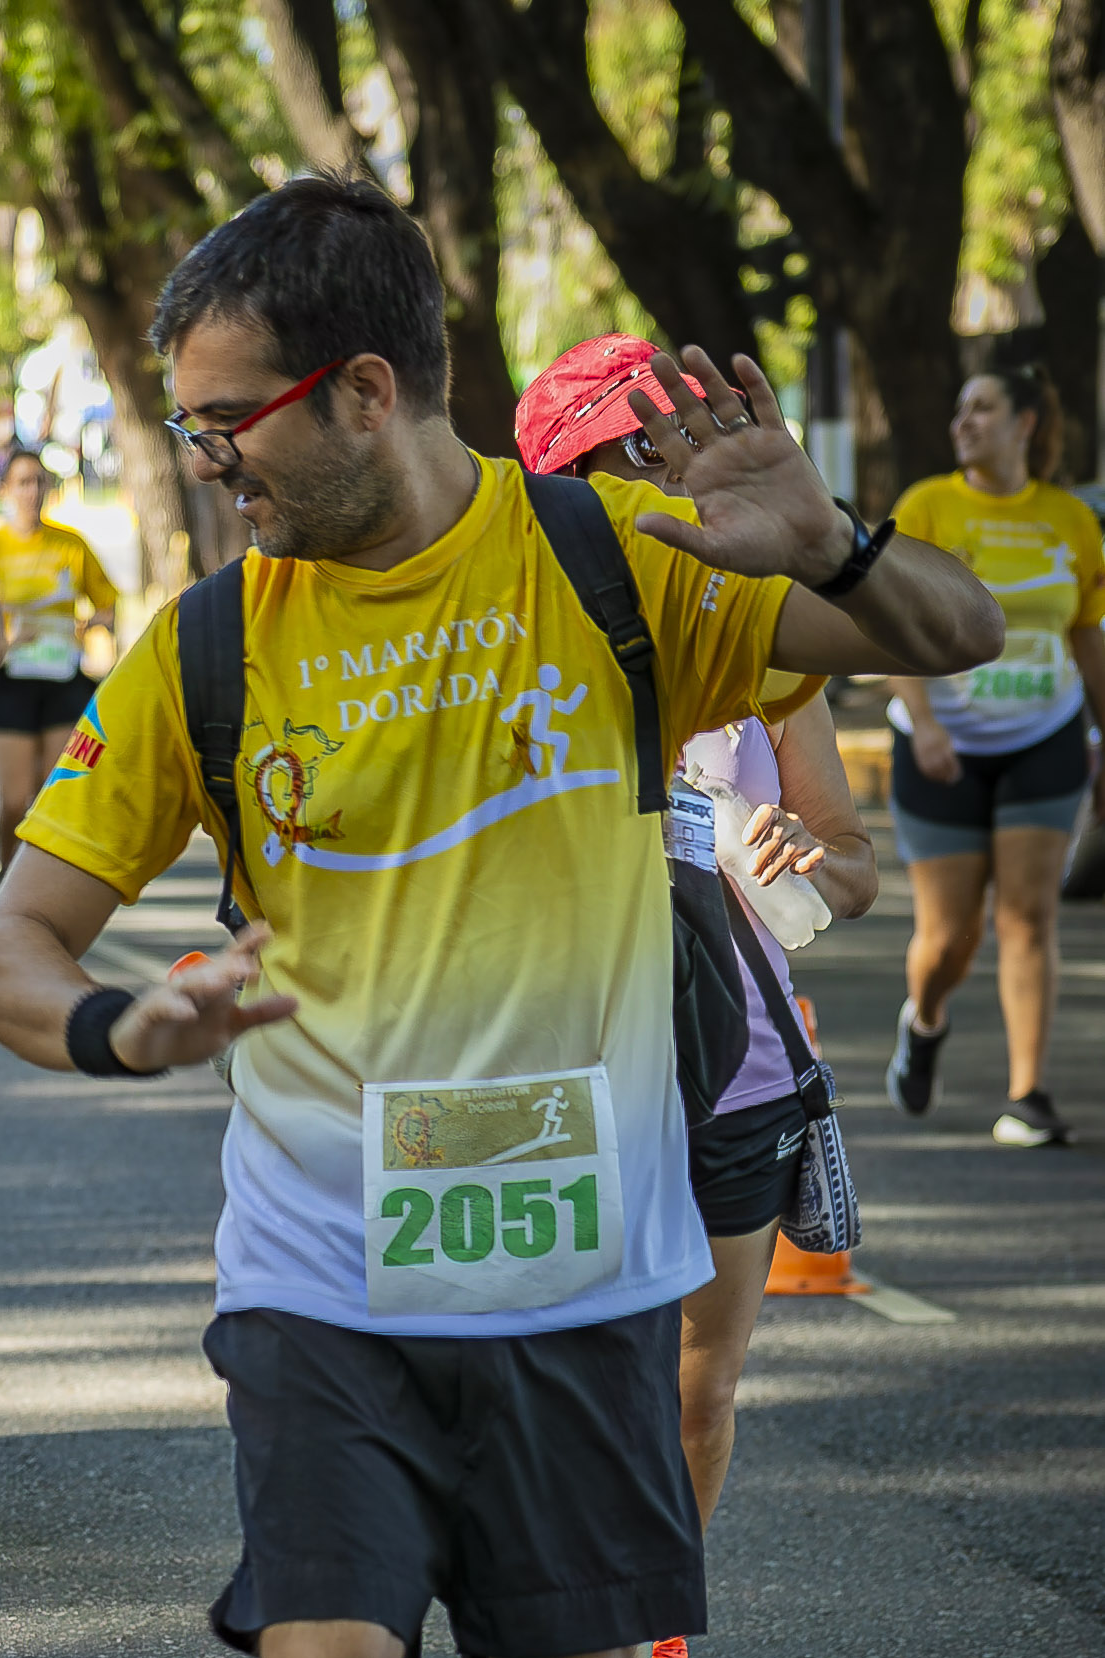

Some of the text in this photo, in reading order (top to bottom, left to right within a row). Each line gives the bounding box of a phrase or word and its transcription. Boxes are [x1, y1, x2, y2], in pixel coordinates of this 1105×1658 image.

[339, 606, 529, 681] MARATÓN
[338, 668, 503, 732] DORADA
[382, 1174, 599, 1266] 2051
